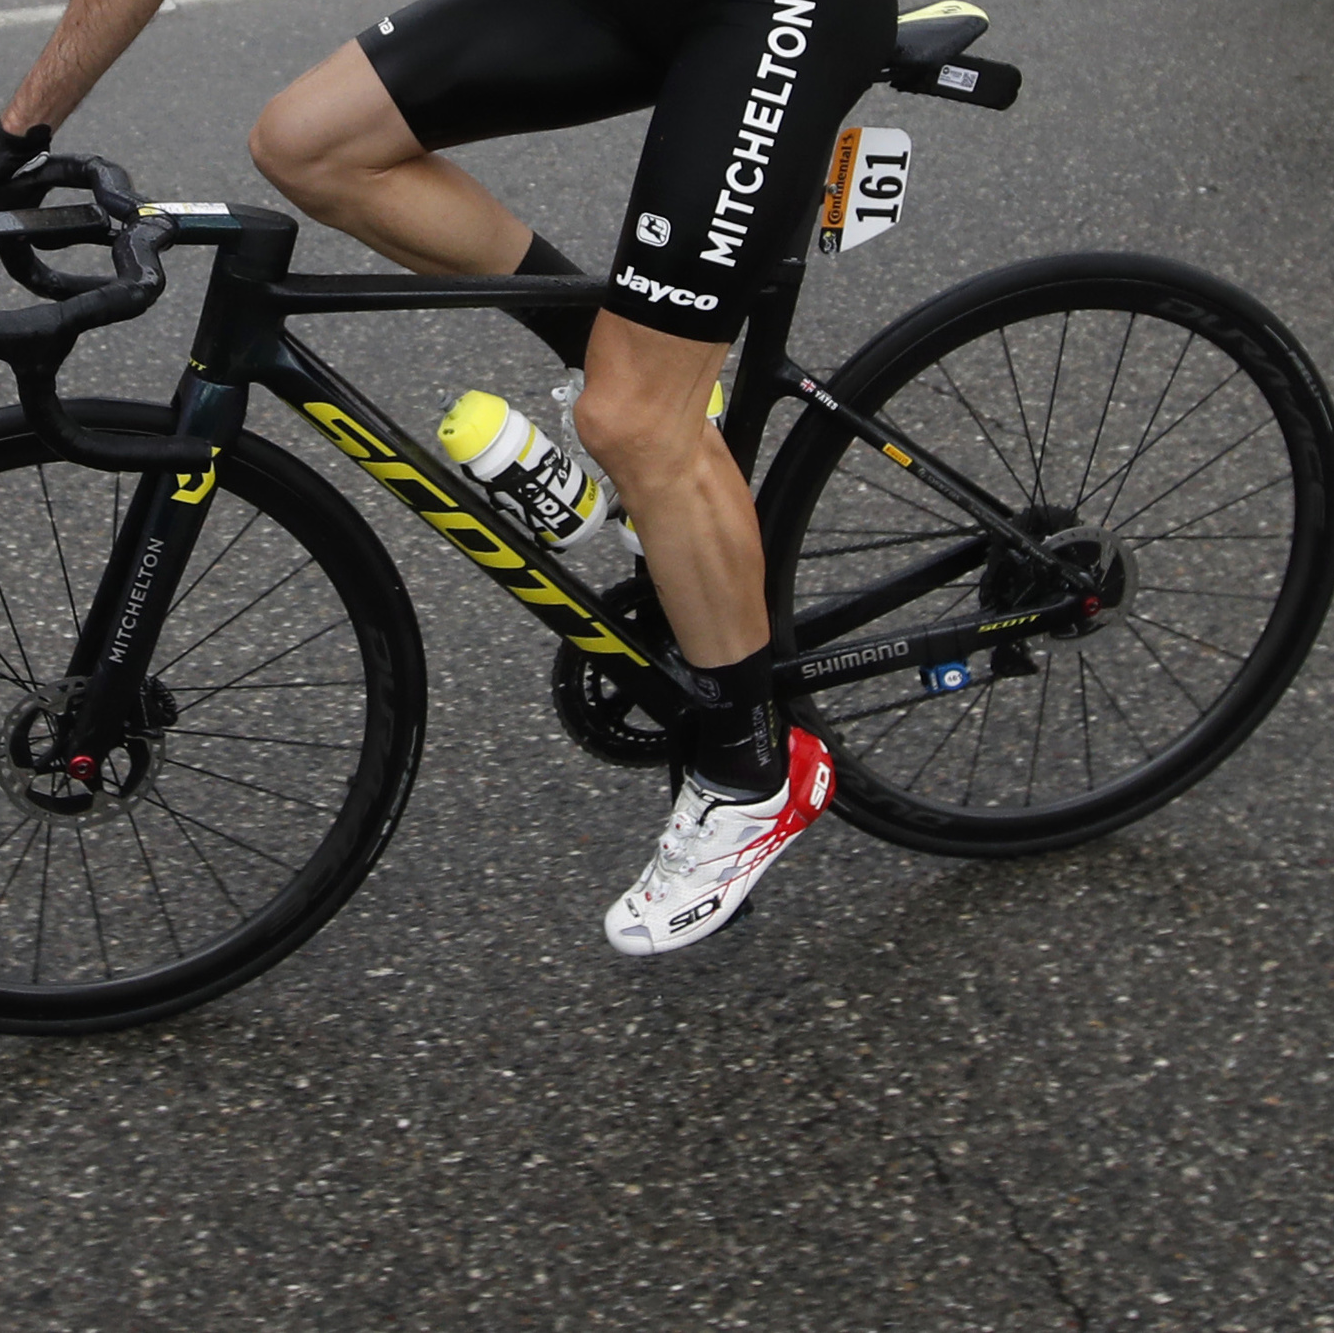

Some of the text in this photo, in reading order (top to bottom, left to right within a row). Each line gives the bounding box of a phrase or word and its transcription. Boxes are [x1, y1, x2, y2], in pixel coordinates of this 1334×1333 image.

[856, 149, 910, 225] 161
[615, 265, 719, 313] Jayco
[303, 401, 651, 668] SCOTT
[108, 535, 165, 665] MITCHELTON
[976, 612, 1041, 635] SCOTT
[800, 639, 910, 681] SHIMANO
